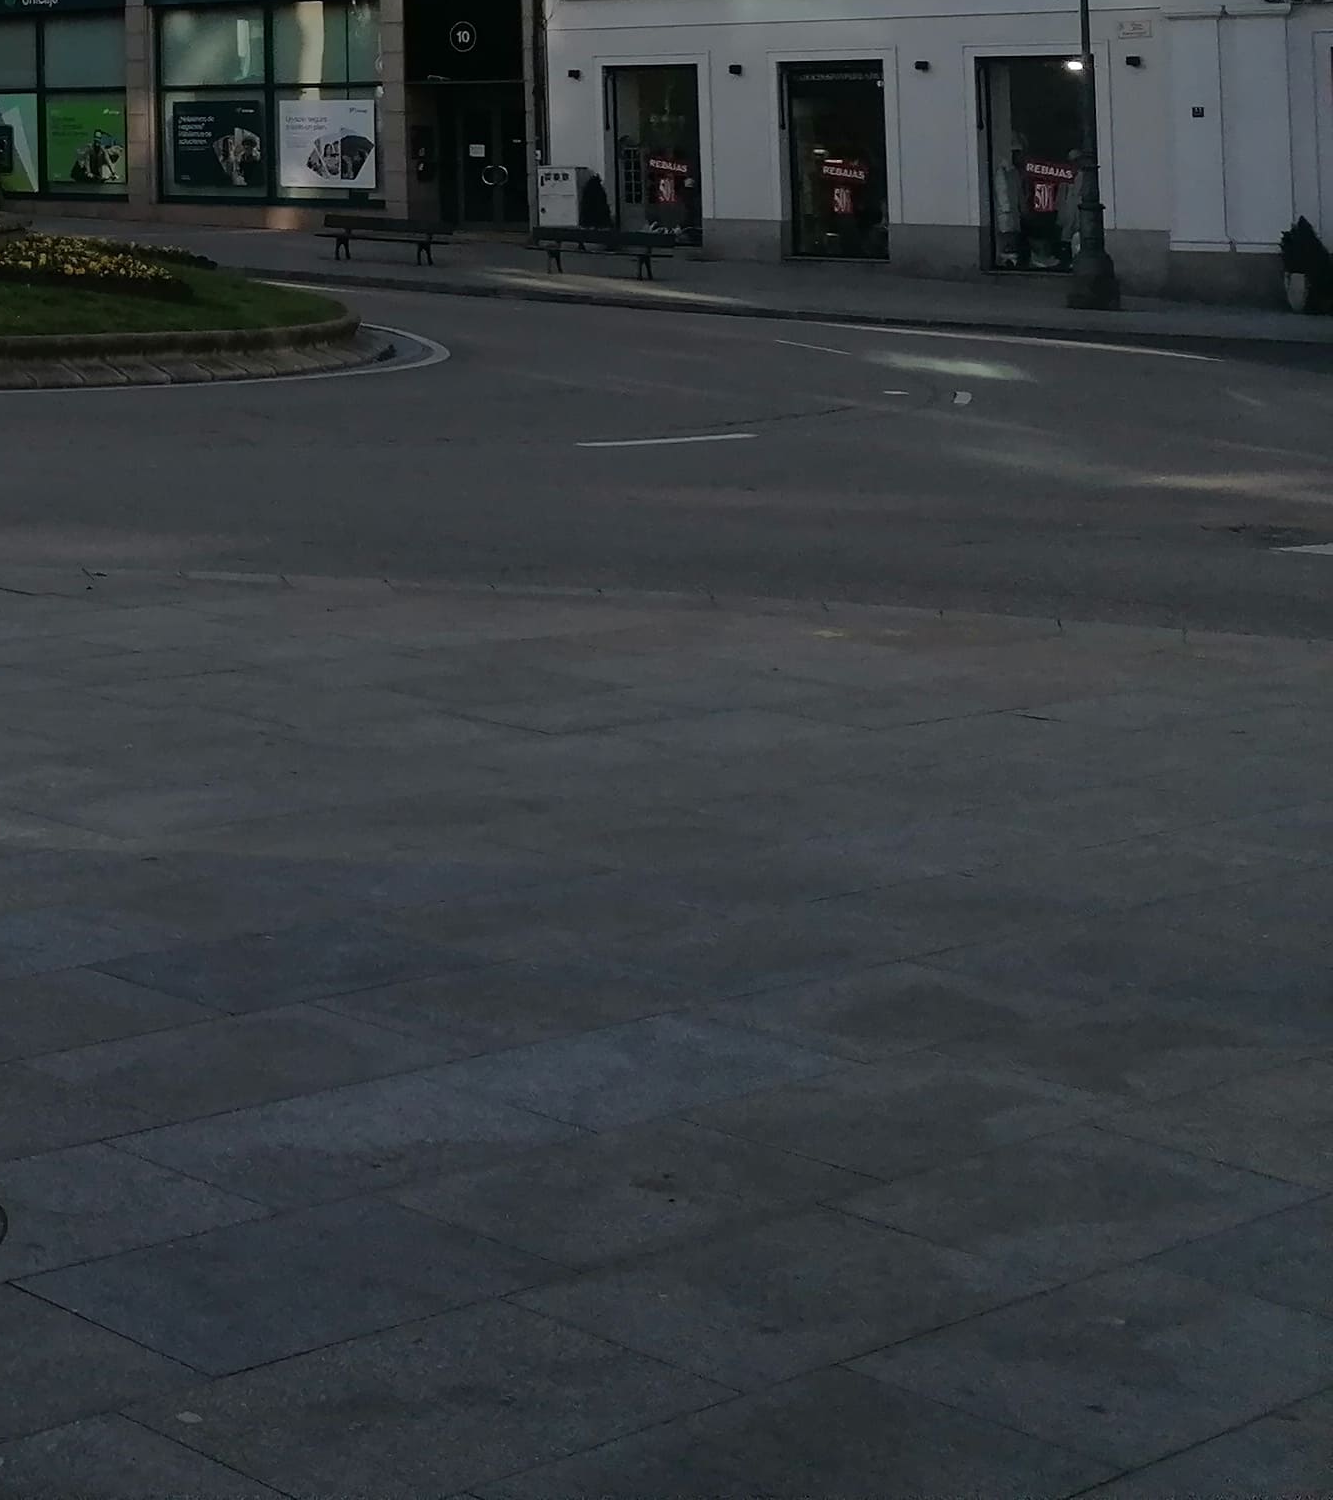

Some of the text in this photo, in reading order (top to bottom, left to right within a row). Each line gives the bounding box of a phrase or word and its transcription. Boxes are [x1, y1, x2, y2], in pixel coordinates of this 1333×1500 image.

[457, 30, 471, 43] 10
[649, 159, 688, 173] REBAJAS
[822, 166, 865, 180] REBAJAS
[1026, 163, 1074, 179] REBAJAS
